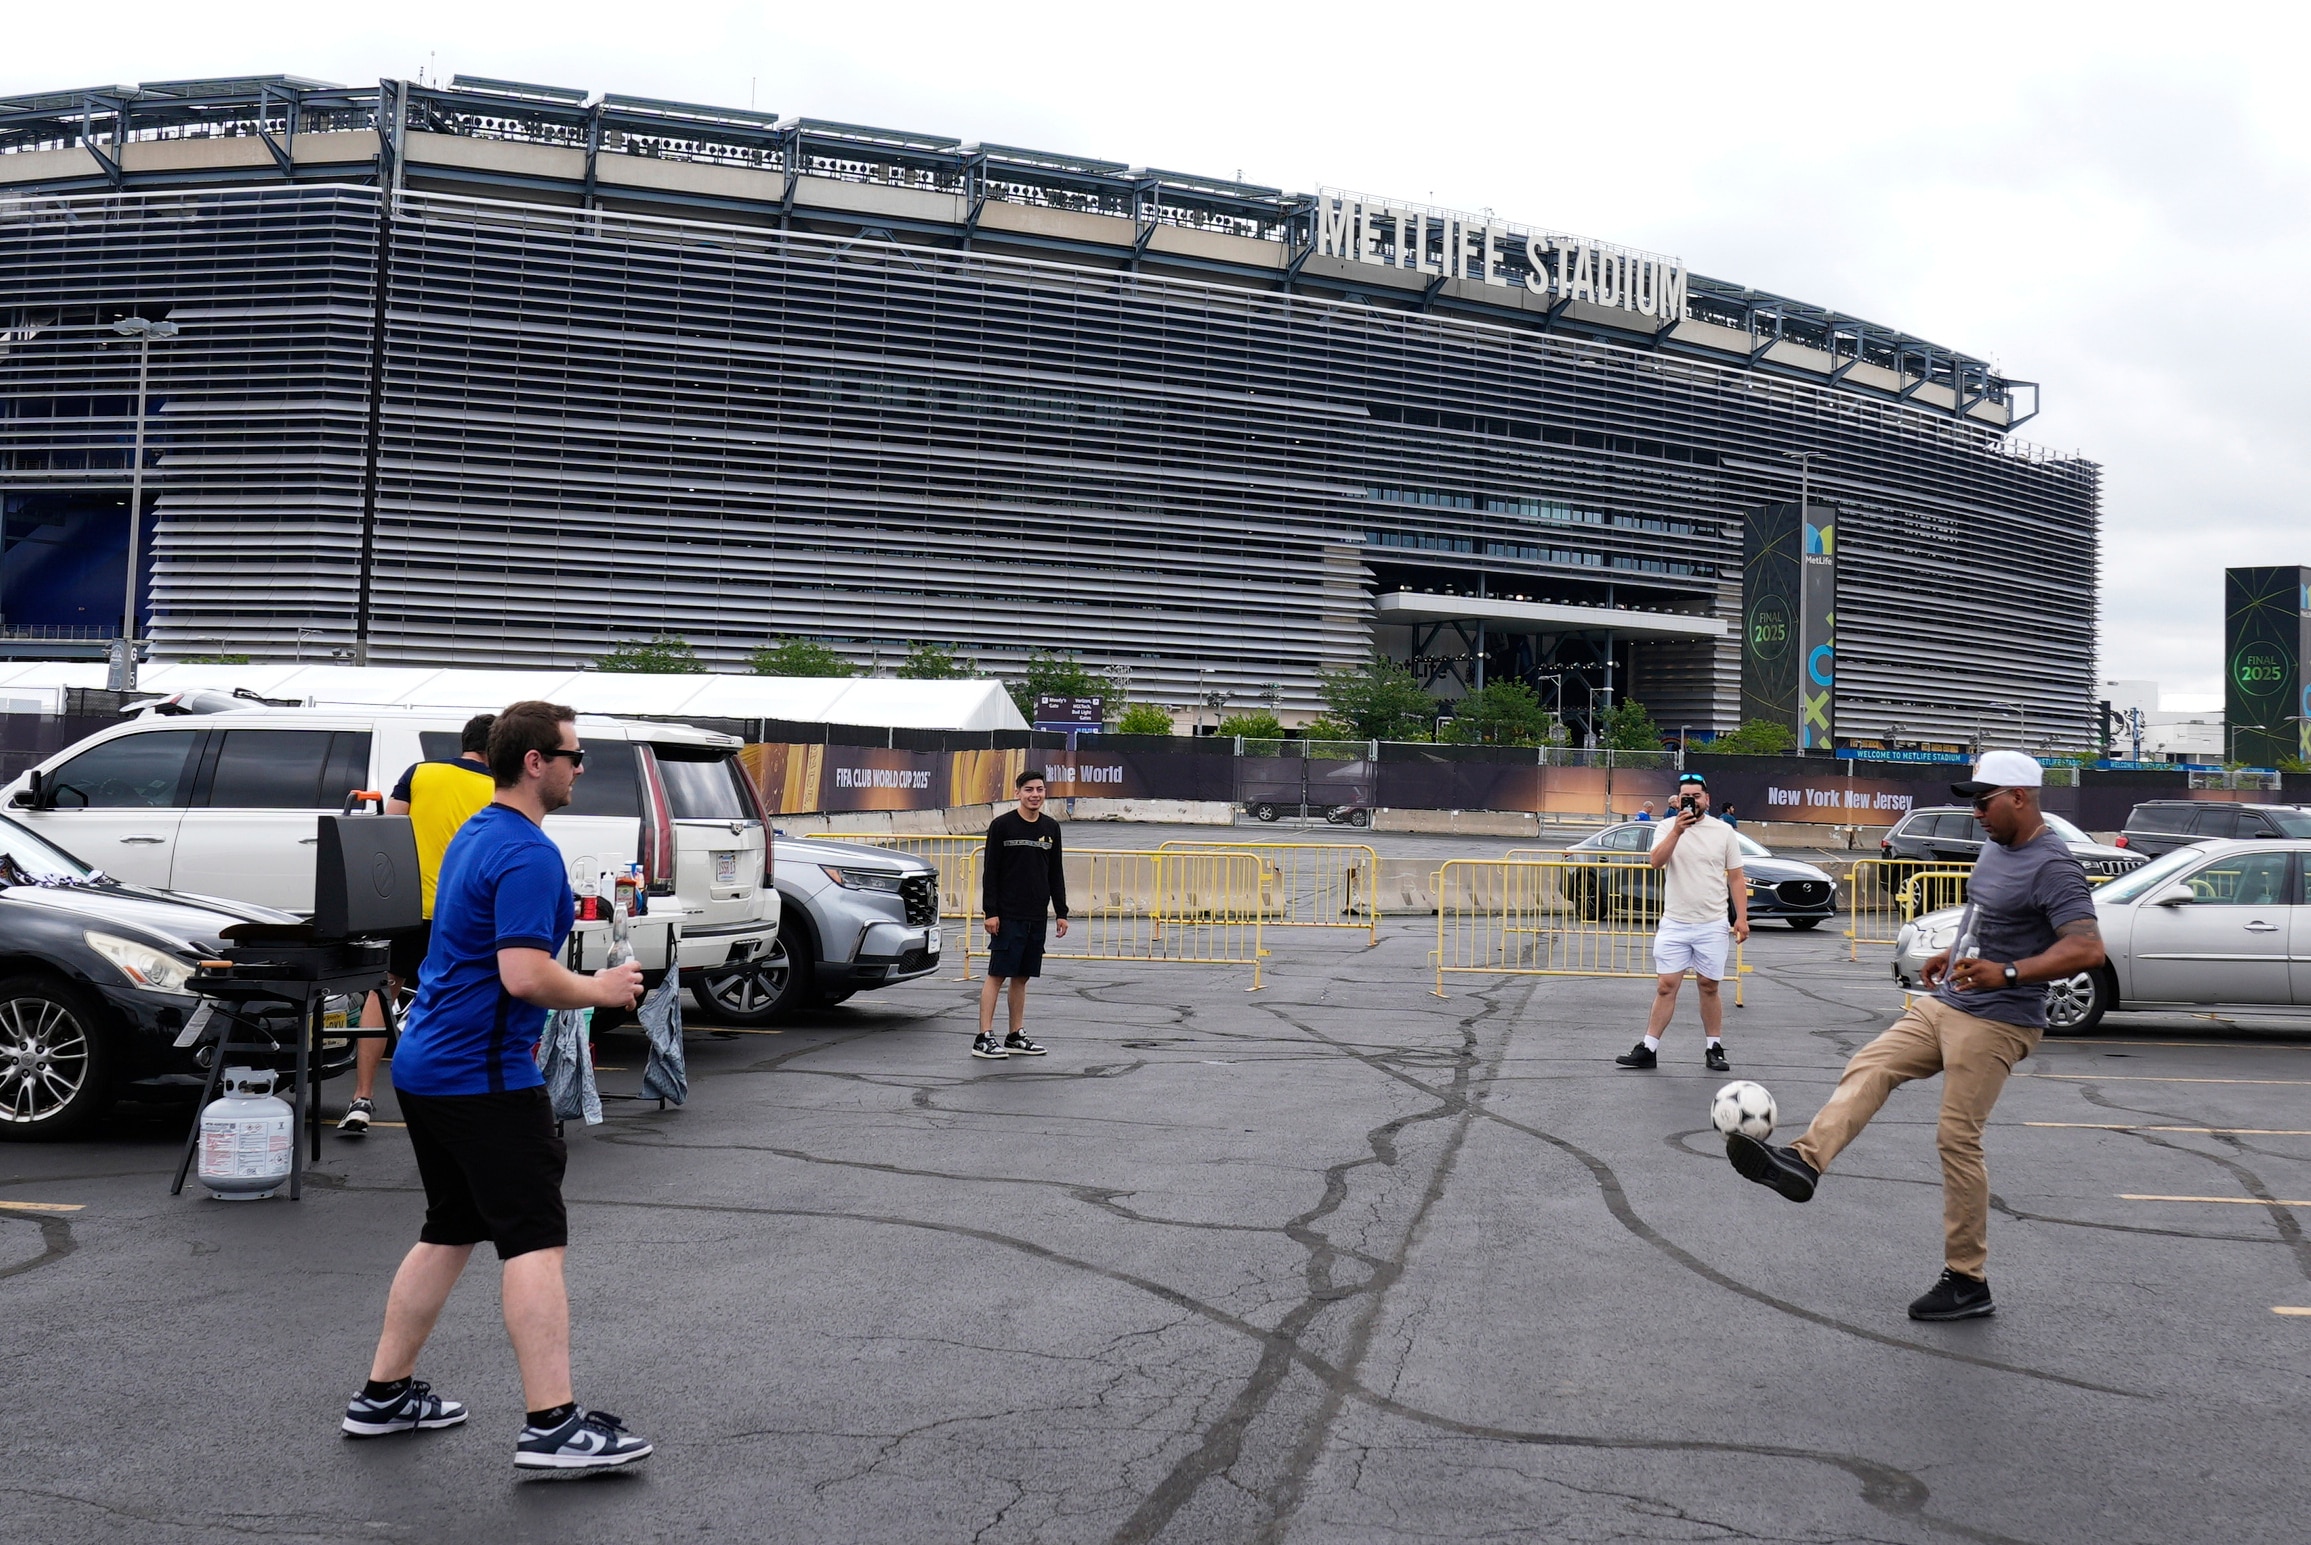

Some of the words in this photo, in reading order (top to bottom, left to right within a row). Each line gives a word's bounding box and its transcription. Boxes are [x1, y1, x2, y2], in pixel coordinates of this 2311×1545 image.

[1317, 195, 1507, 288] METLIFE
[1524, 235, 1687, 322] STADIUM
[1805, 555, 1832, 565] MetLife
[1759, 613, 1782, 623] FINAL
[1755, 624, 1785, 642] 2025
[131, 647, 138, 661] G
[2248, 656, 2276, 665] FINAL
[130, 672, 135, 686] 5
[2241, 666, 2281, 680] 2025
[1857, 750, 1890, 759] WELCOME
[1892, 751, 1901, 759] TO
[1903, 752, 1931, 761] METLIFE
[1933, 753, 1961, 762] STADIUM
[836, 768, 852, 787] FIFA
[853, 769, 871, 788] CLUB
[873, 769, 898, 788] WORLD
[899, 771, 912, 788] CUP
[1080, 765, 1123, 783] World
[1768, 787, 1801, 806] New
[1806, 788, 1840, 808] York
[1844, 790, 1870, 809] New
[1873, 791, 1913, 811] Jersey
